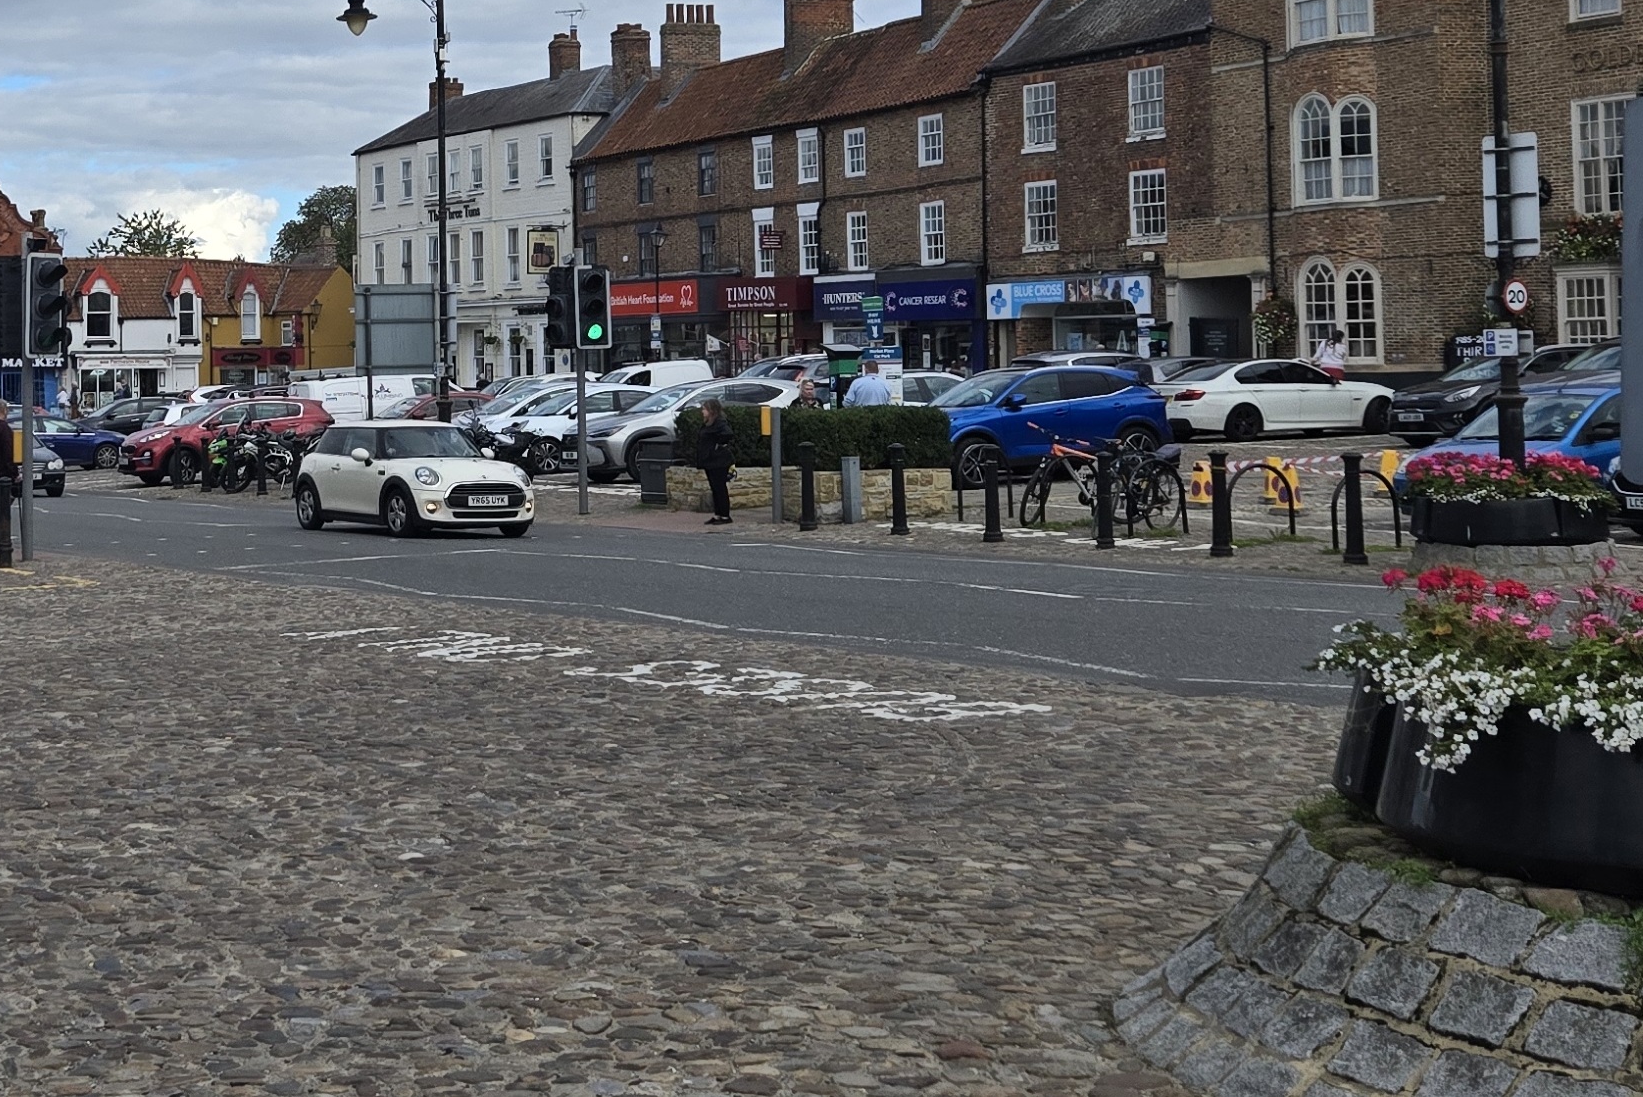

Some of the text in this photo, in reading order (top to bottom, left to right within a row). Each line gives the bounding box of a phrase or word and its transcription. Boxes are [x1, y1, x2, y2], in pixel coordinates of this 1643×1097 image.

[726, 286, 776, 301] TIMPSON
[1013, 283, 1062, 297] BLUE CROSS
[627, 294, 642, 305] Heart
[642, 293, 674, 304] Founation
[823, 291, 863, 305] HUNTERS
[899, 296, 923, 306] CANCER
[1508, 290, 1525, 303] 20
[1, 358, 65, 368] MAKET
[471, 496, 505, 504] YR65 UYK
